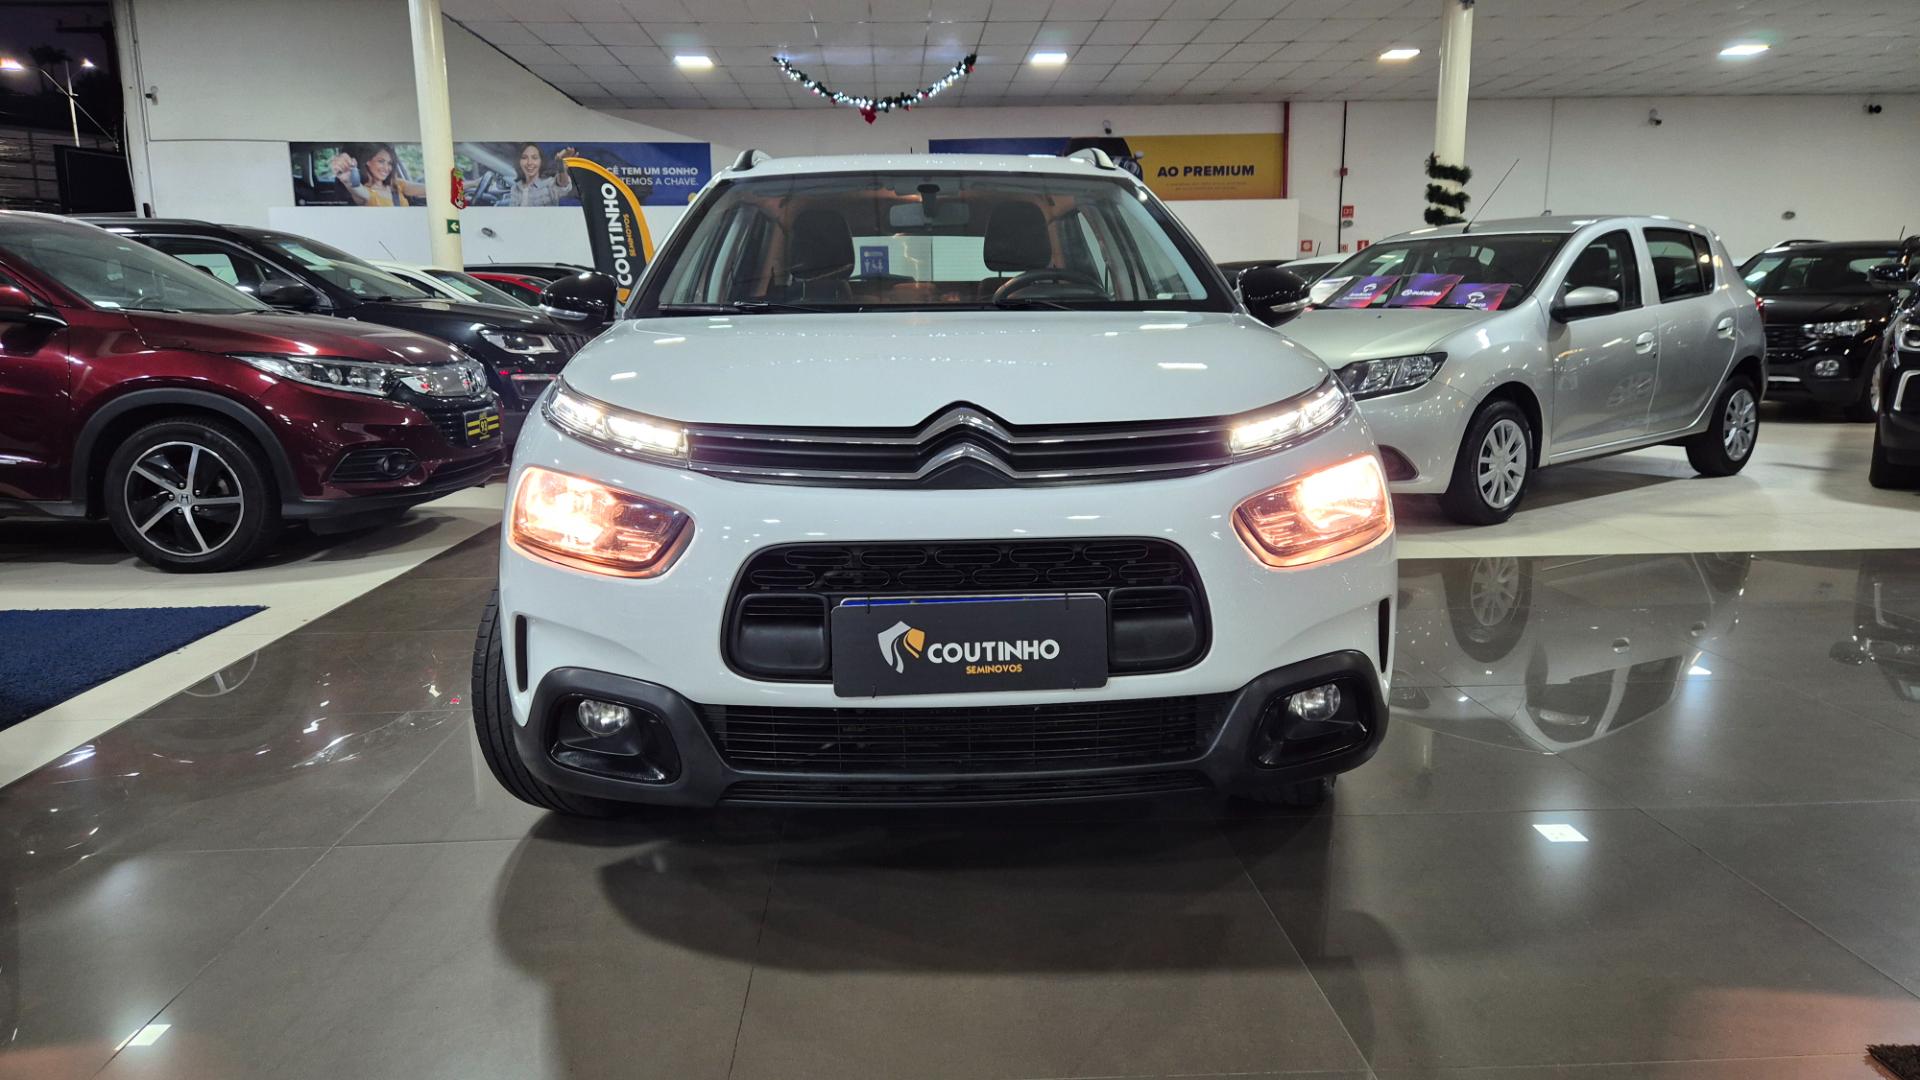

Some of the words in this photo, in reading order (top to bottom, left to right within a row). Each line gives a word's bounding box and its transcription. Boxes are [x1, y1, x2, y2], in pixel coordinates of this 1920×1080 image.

[607, 164, 619, 175] CÊ
[621, 167, 642, 175] TEM
[643, 167, 660, 175] UM
[662, 167, 698, 175] SONHO
[1157, 166, 1179, 177] AO
[1183, 165, 1254, 177] PREMIUM
[655, 177, 663, 185] A
[664, 177, 699, 186] CHAVE.
[601, 183, 632, 286] COUTINHO
[927, 639, 1060, 664] COUTINHO
[966, 664, 1022, 675] SEMINOVOS
